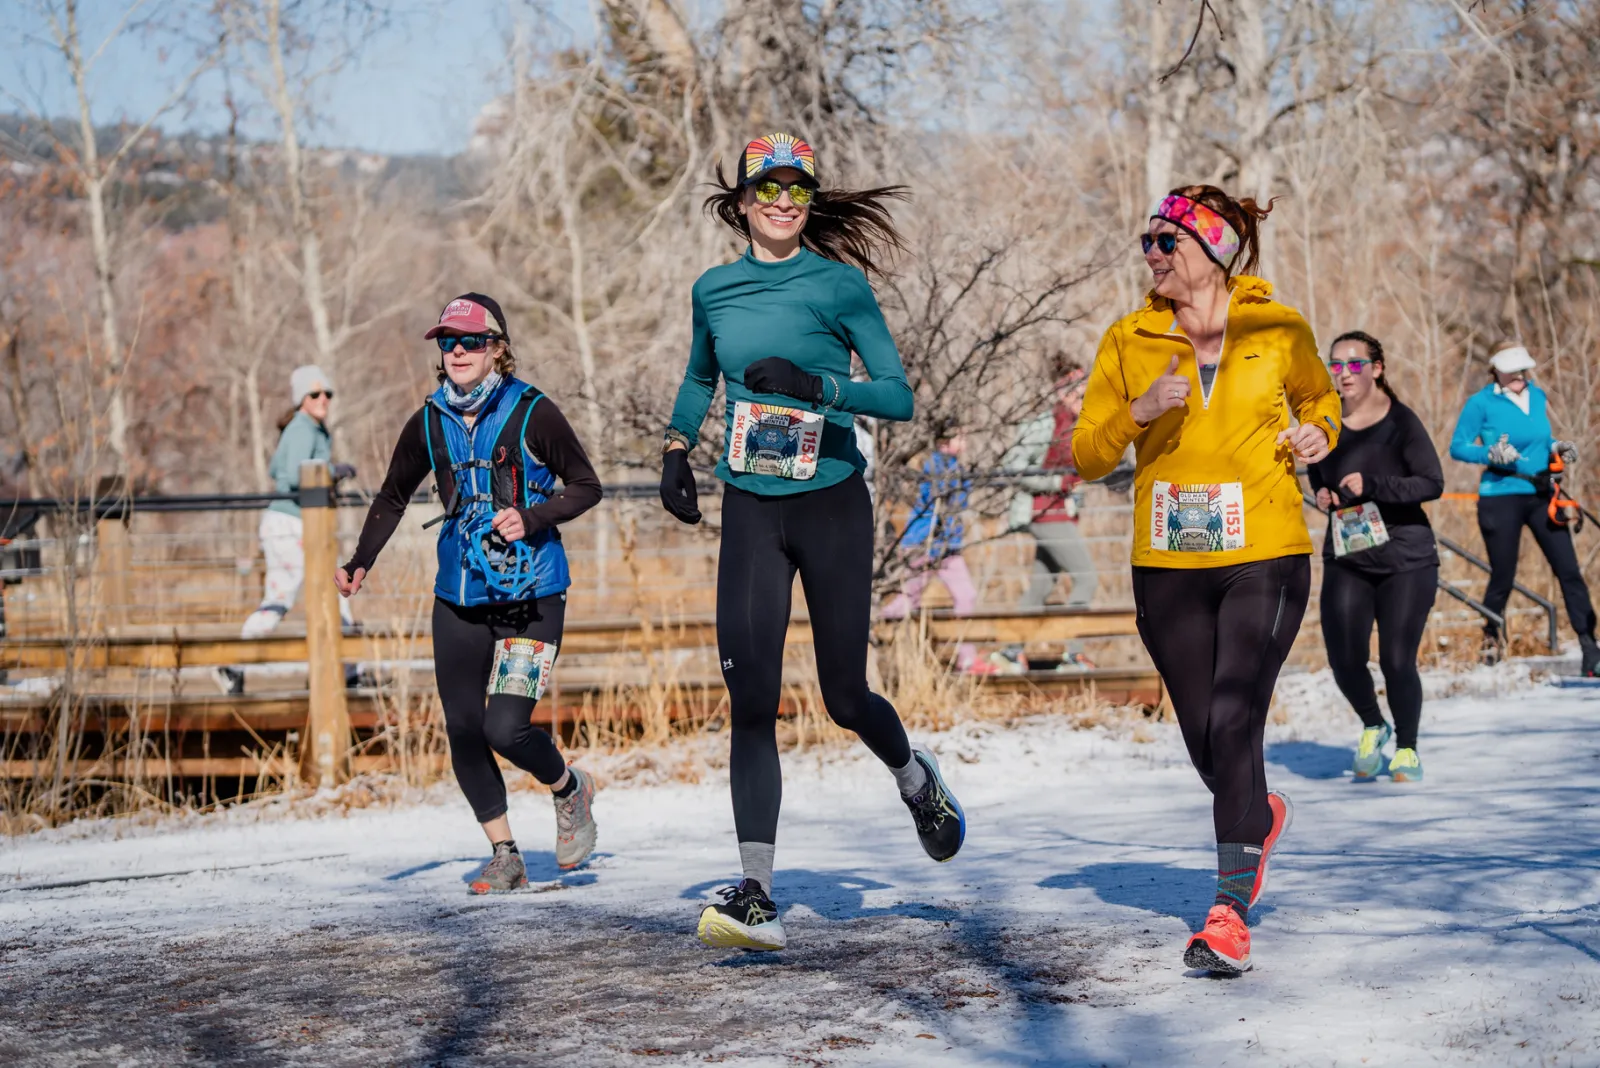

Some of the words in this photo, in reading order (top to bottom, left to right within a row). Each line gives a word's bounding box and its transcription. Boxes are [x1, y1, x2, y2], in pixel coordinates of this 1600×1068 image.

[737, 415, 745, 430] 5K
[732, 433, 742, 459] RUN
[800, 430, 817, 464] 1154
[1155, 493, 1164, 509] 5K
[1154, 512, 1163, 538] RUN
[1226, 501, 1241, 536] 1153
[540, 660, 551, 687] 1134
